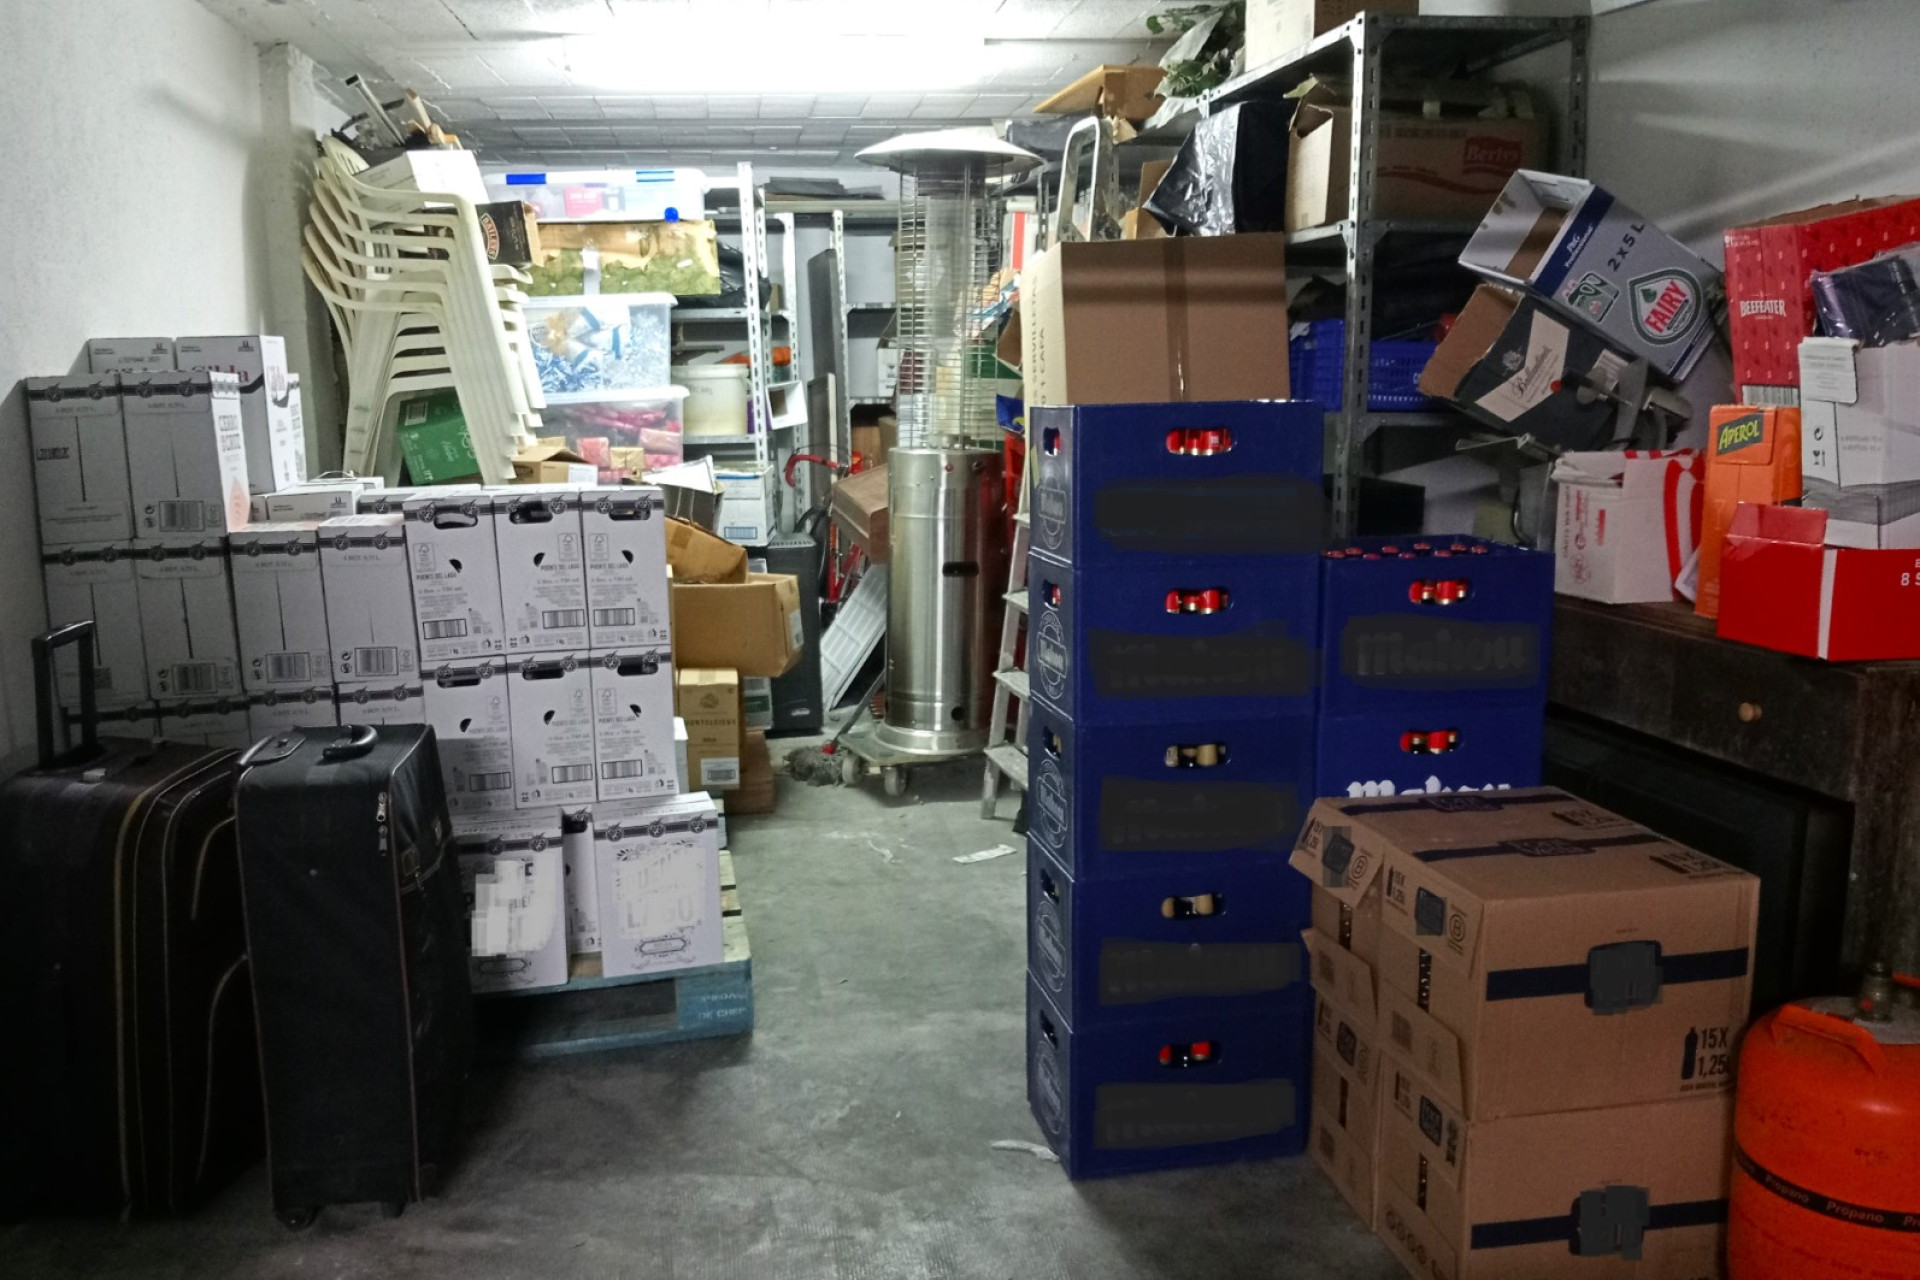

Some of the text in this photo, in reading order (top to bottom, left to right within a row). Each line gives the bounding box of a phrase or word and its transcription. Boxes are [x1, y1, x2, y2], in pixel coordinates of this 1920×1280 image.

[1608, 257, 1621, 273] 2
[1622, 233, 1636, 248] 5
[1631, 222, 1646, 235] L
[1643, 279, 1688, 334] FAIRY
[1739, 298, 1787, 318] BEEFEATER
[1718, 419, 1760, 451] APEROL
[1900, 572, 1911, 587] 8
[1701, 1026, 1729, 1050] 15X
[1764, 1174, 1810, 1204] Propano
[1826, 1200, 1885, 1224] Propano
